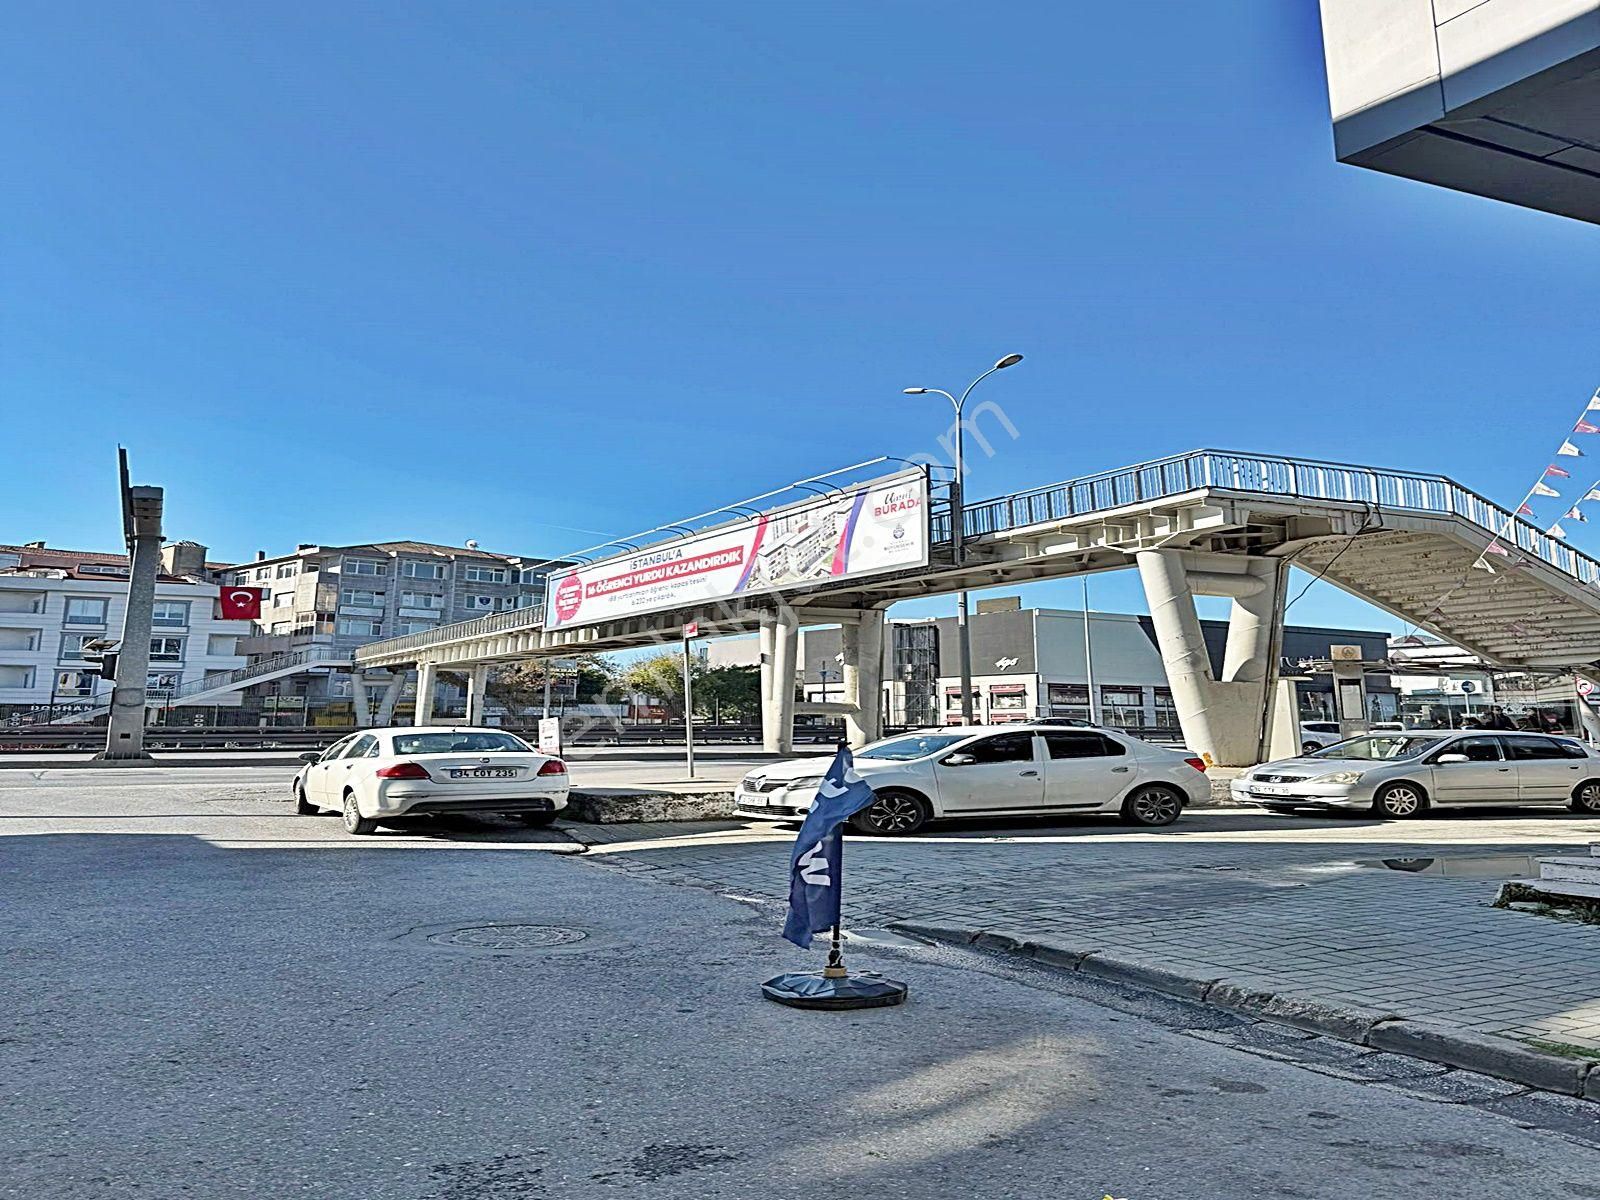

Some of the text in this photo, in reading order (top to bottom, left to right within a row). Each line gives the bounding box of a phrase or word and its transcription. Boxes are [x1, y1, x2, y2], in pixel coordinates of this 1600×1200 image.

[874, 499, 922, 517] BURADA
[596, 574, 632, 593] ÖĞRENCİ
[633, 567, 666, 586] YURDU
[664, 550, 742, 579] KAZANDIRDIK
[495, 769, 514, 777] 235
